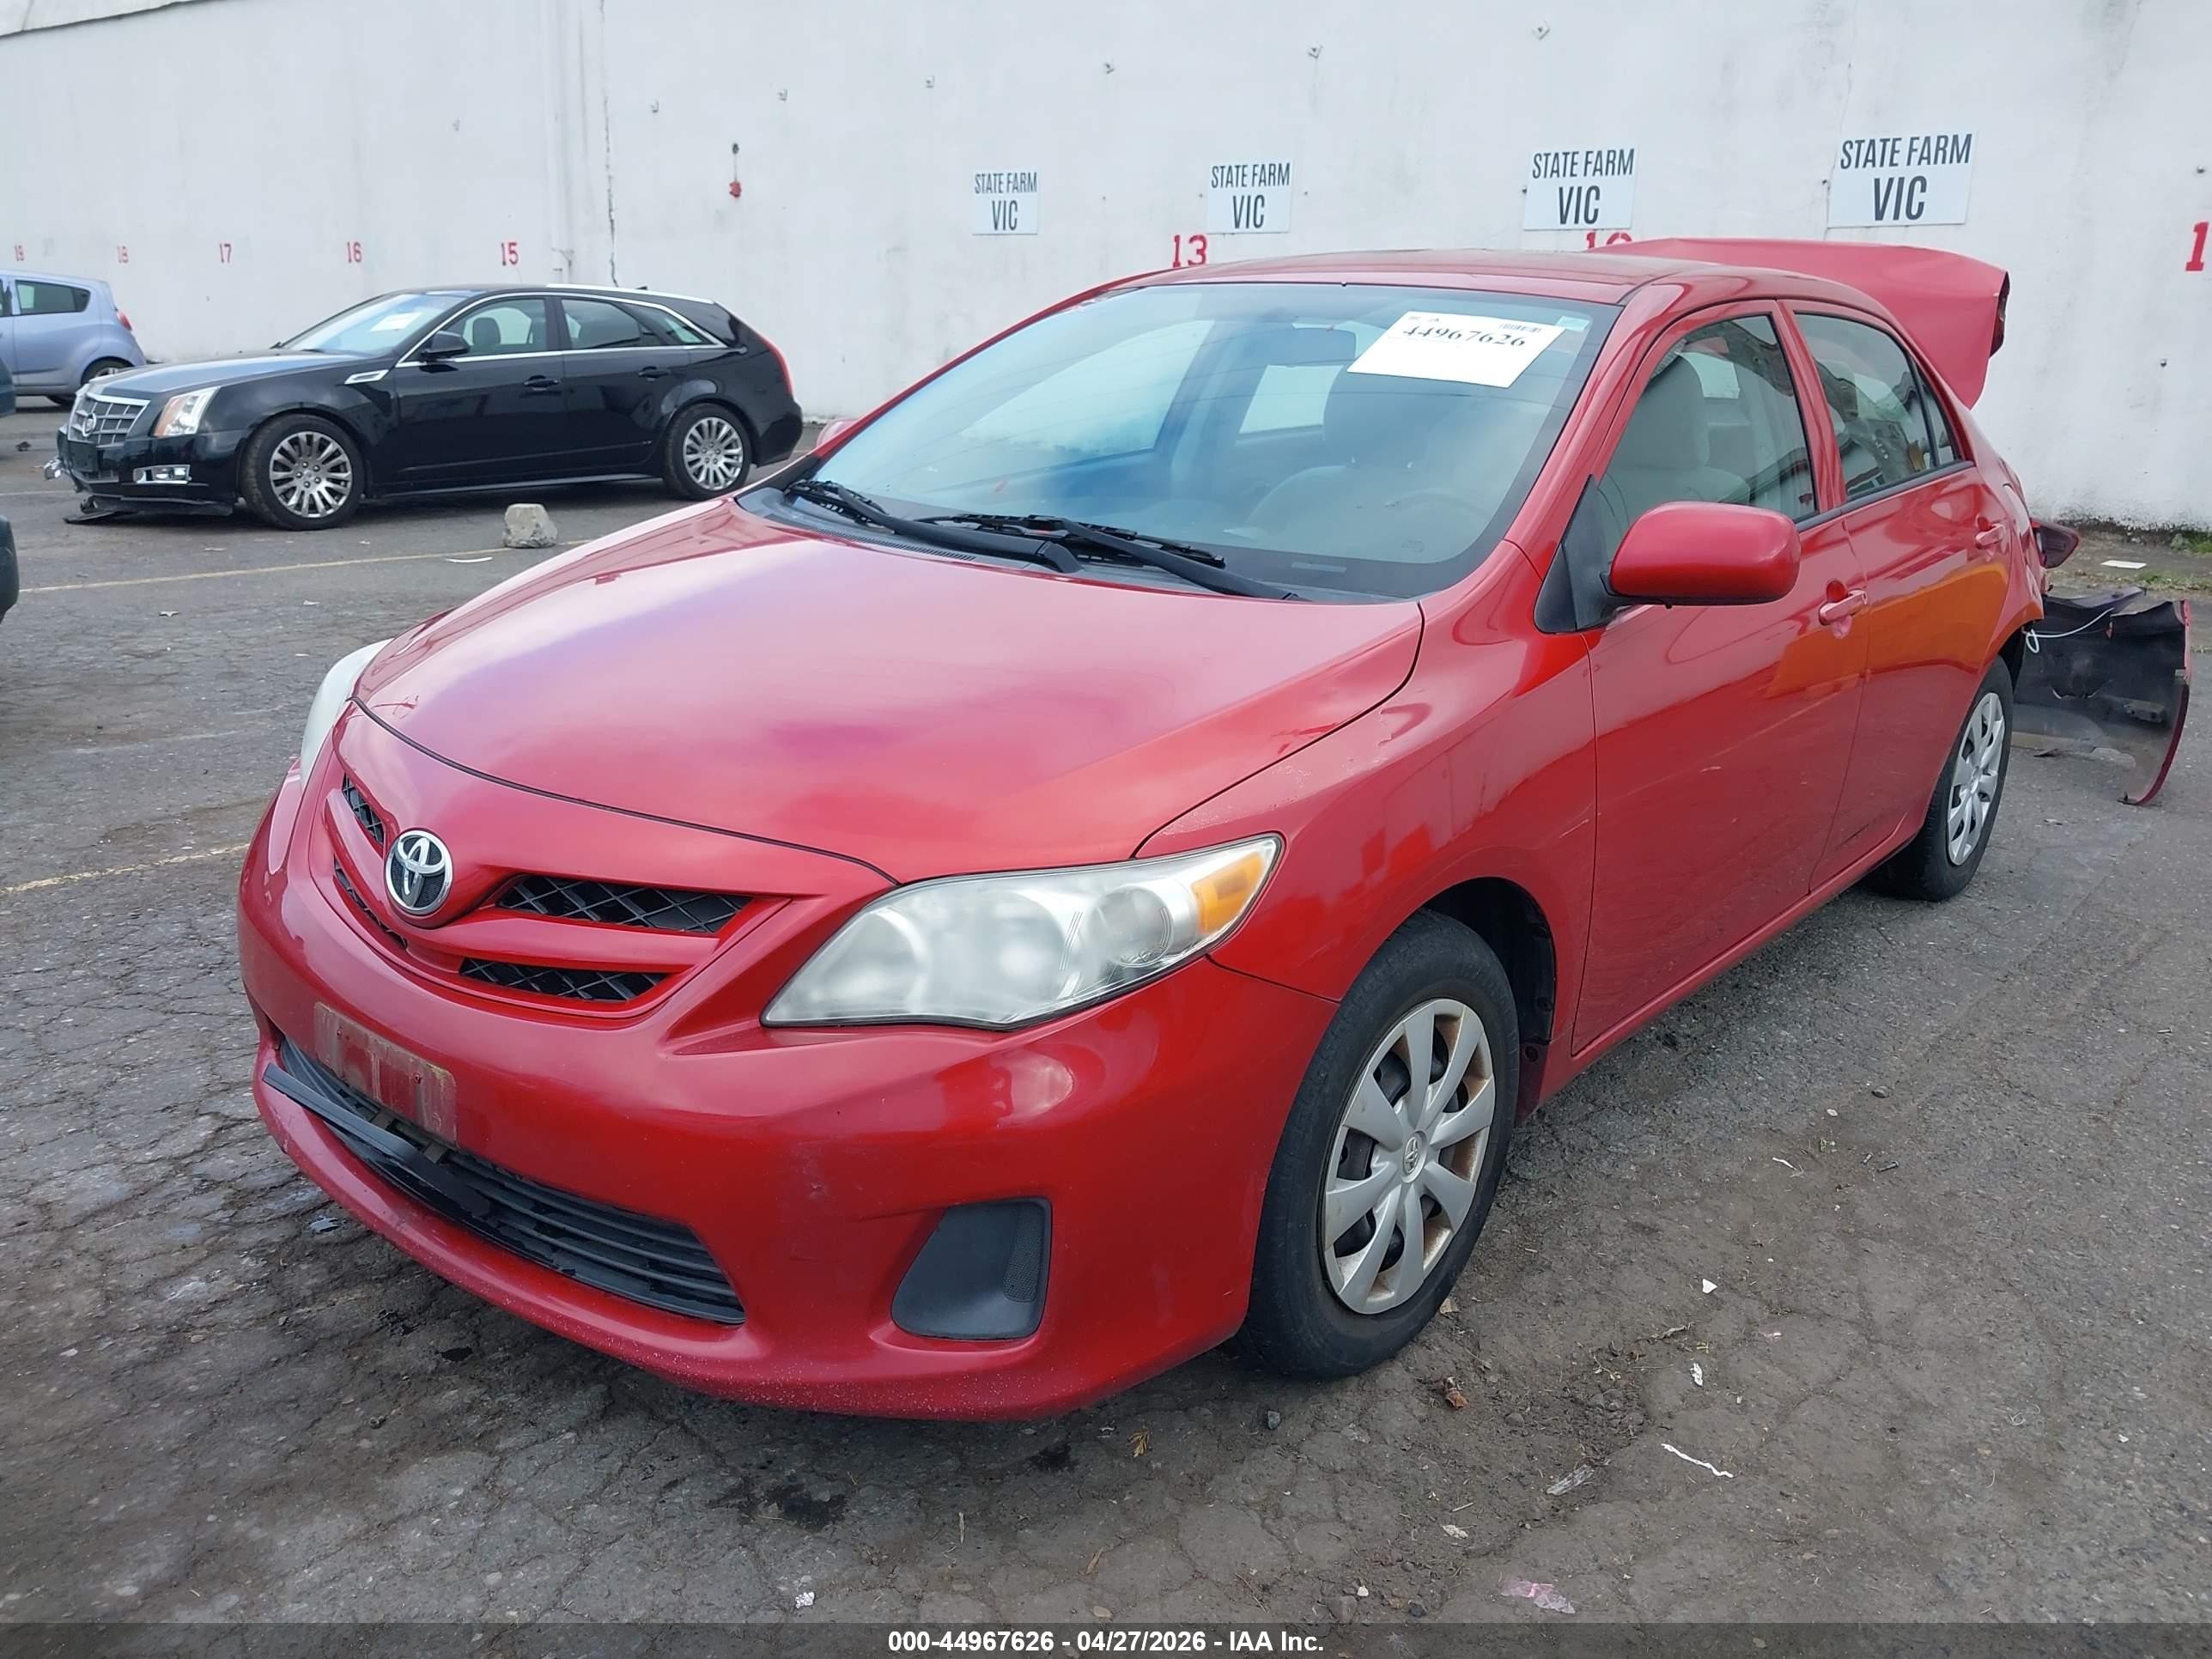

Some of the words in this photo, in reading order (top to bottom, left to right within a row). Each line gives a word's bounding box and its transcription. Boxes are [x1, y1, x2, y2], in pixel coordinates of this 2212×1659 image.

[1532, 151, 1579, 179] STATE
[1583, 149, 1634, 177] FARM
[1840, 137, 1902, 170] STATE
[1906, 133, 1972, 167] FARM
[975, 173, 1003, 194] STATE
[1007, 172, 1036, 192] FARM
[1211, 165, 1248, 188] STATE
[1252, 162, 1291, 187] FARM
[1232, 194, 1265, 229] VIC
[1559, 185, 1601, 225] VIC
[1874, 175, 1927, 222] VIC
[992, 199, 1018, 231] VIC
[219, 243, 232, 264] 17
[347, 241, 362, 264] 16
[501, 241, 519, 266] 15
[1172, 234, 1207, 268] 13
[1402, 325, 1525, 347] 44967626
